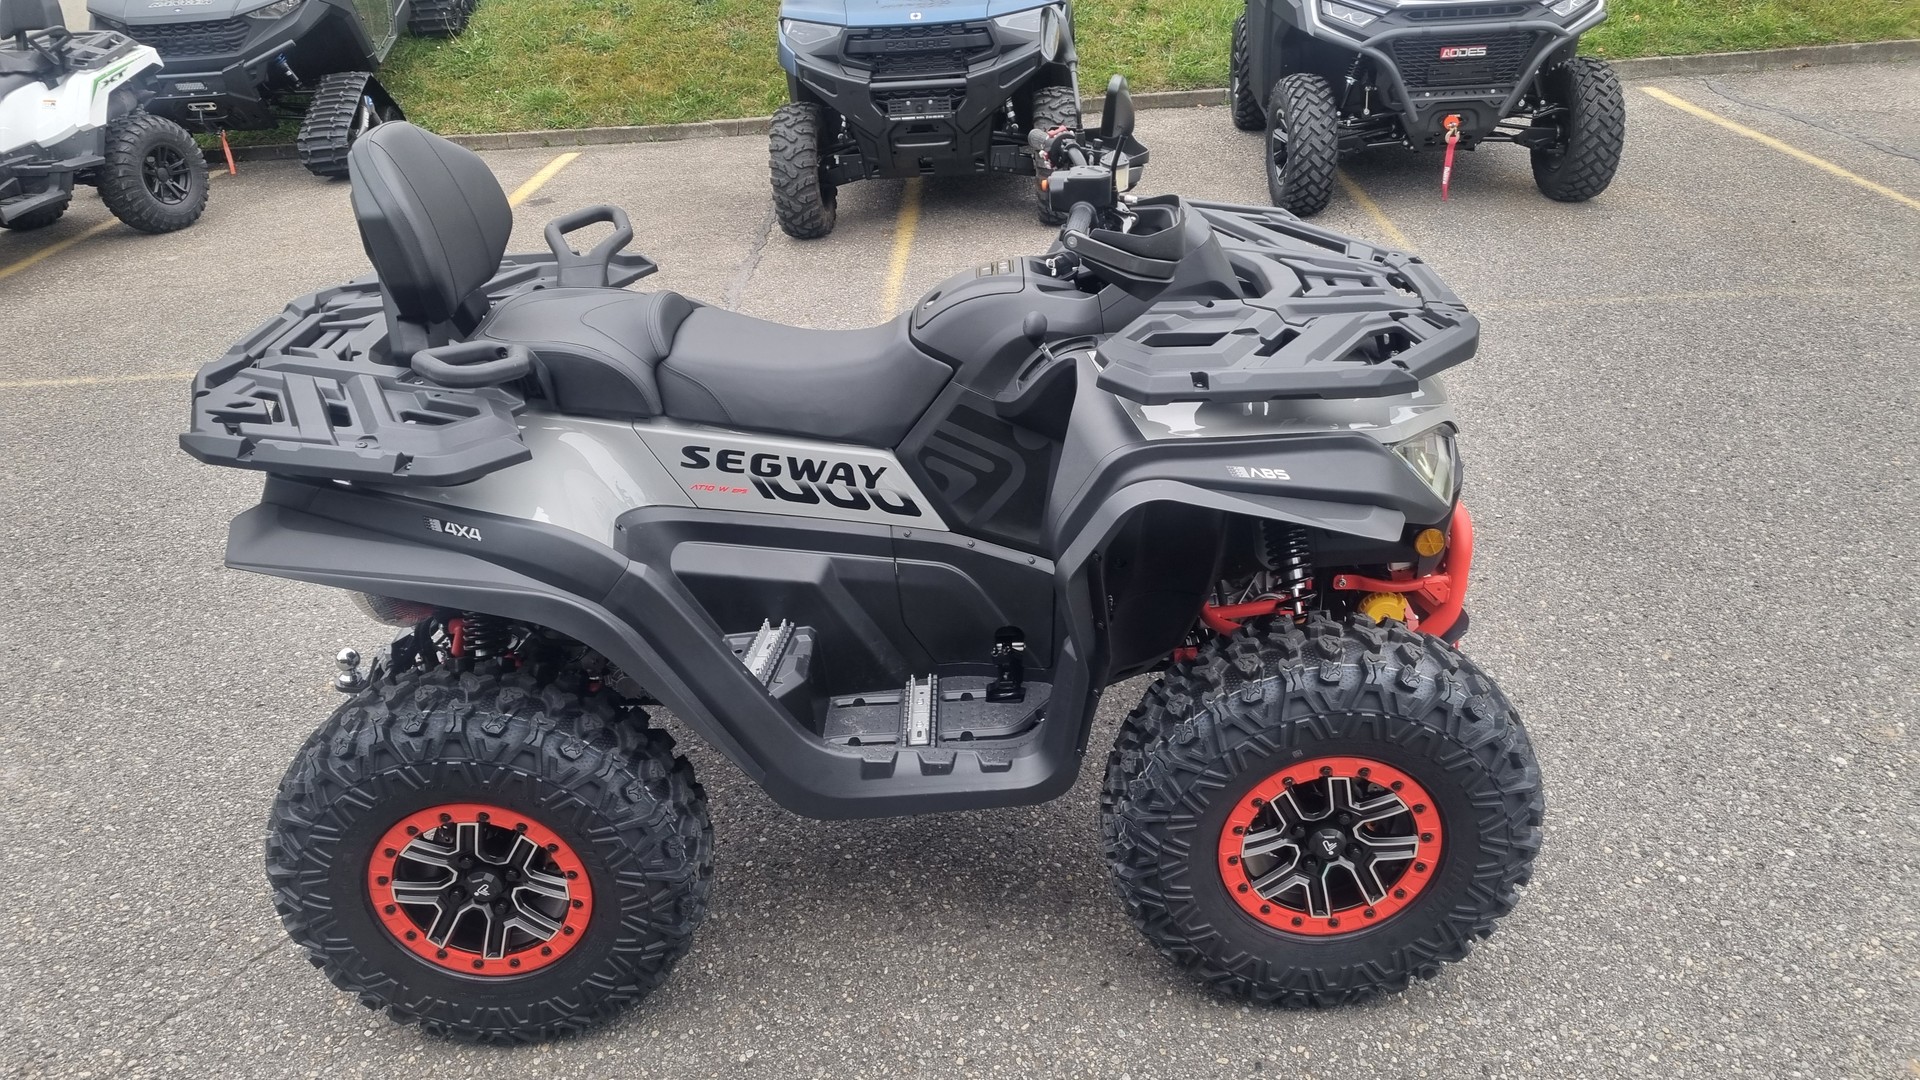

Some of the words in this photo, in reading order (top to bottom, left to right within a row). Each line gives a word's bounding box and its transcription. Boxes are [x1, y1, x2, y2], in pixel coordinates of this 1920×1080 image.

[885, 38, 951, 51] POLARIS
[1441, 46, 1488, 58] AODES
[680, 445, 888, 490] SEGWAY
[1250, 467, 1291, 481] ABS
